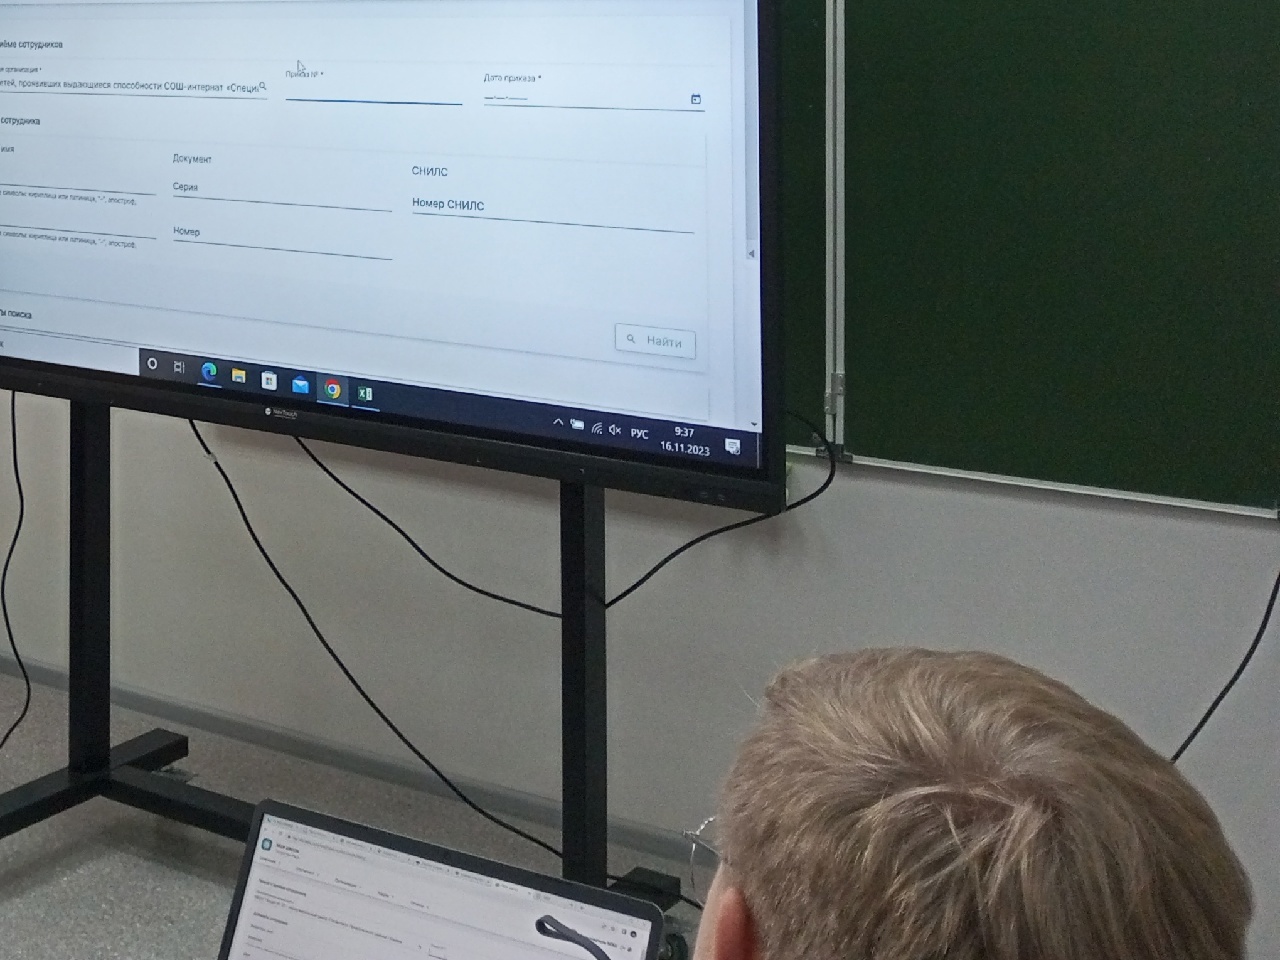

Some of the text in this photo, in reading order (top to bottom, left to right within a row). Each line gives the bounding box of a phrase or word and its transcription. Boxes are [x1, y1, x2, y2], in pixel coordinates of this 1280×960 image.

[18, 41, 64, 50] сотрудников
[483, 73, 536, 83] Дата приказа
[18, 80, 62, 89] проявивших
[63, 81, 111, 90] выдающиеся
[113, 81, 162, 91] способности
[164, 81, 223, 93] СОШ-интернат
[0, 116, 41, 126] сотрудника
[0, 145, 15, 153] имя
[173, 153, 212, 164] Документ
[411, 165, 448, 177] СНИЛС
[173, 181, 199, 192] Серия
[412, 197, 485, 211] Номер СНИЛС
[173, 226, 201, 238] Номер
[7, 310, 33, 320] поиска
[647, 335, 682, 349] Найти
[631, 428, 649, 439] РУС
[675, 426, 694, 438] 9:37
[660, 440, 711, 457] 16.11.2023
